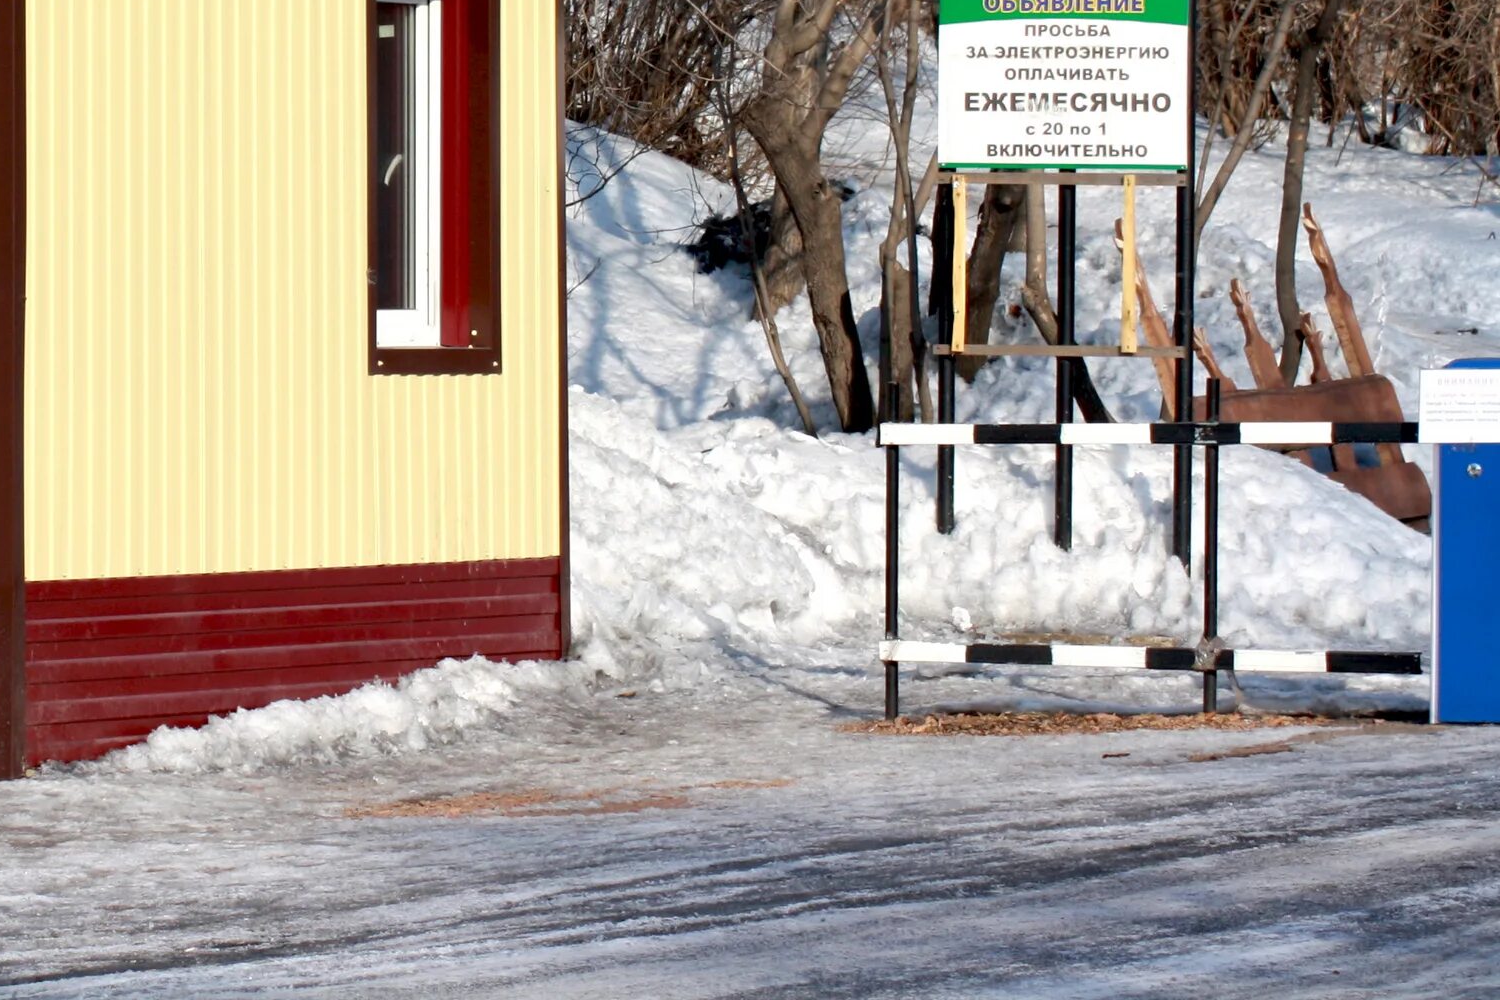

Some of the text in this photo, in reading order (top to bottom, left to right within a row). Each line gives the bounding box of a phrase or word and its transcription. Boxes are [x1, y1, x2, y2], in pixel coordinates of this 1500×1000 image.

[1024, 24, 1111, 37] ПРОСЬБА
[965, 45, 1170, 60] ЗА ЭЛЕКТРОЭНЕРГИЮ
[1004, 67, 1130, 81] ОПЛАЧИВАТЬ
[964, 92, 1172, 113] ЕЖЕМЕСЯЧНО
[1025, 122, 1106, 136] с 20 по 1
[986, 143, 1148, 158] ВКЛЮЧИТЕЛЬНО
